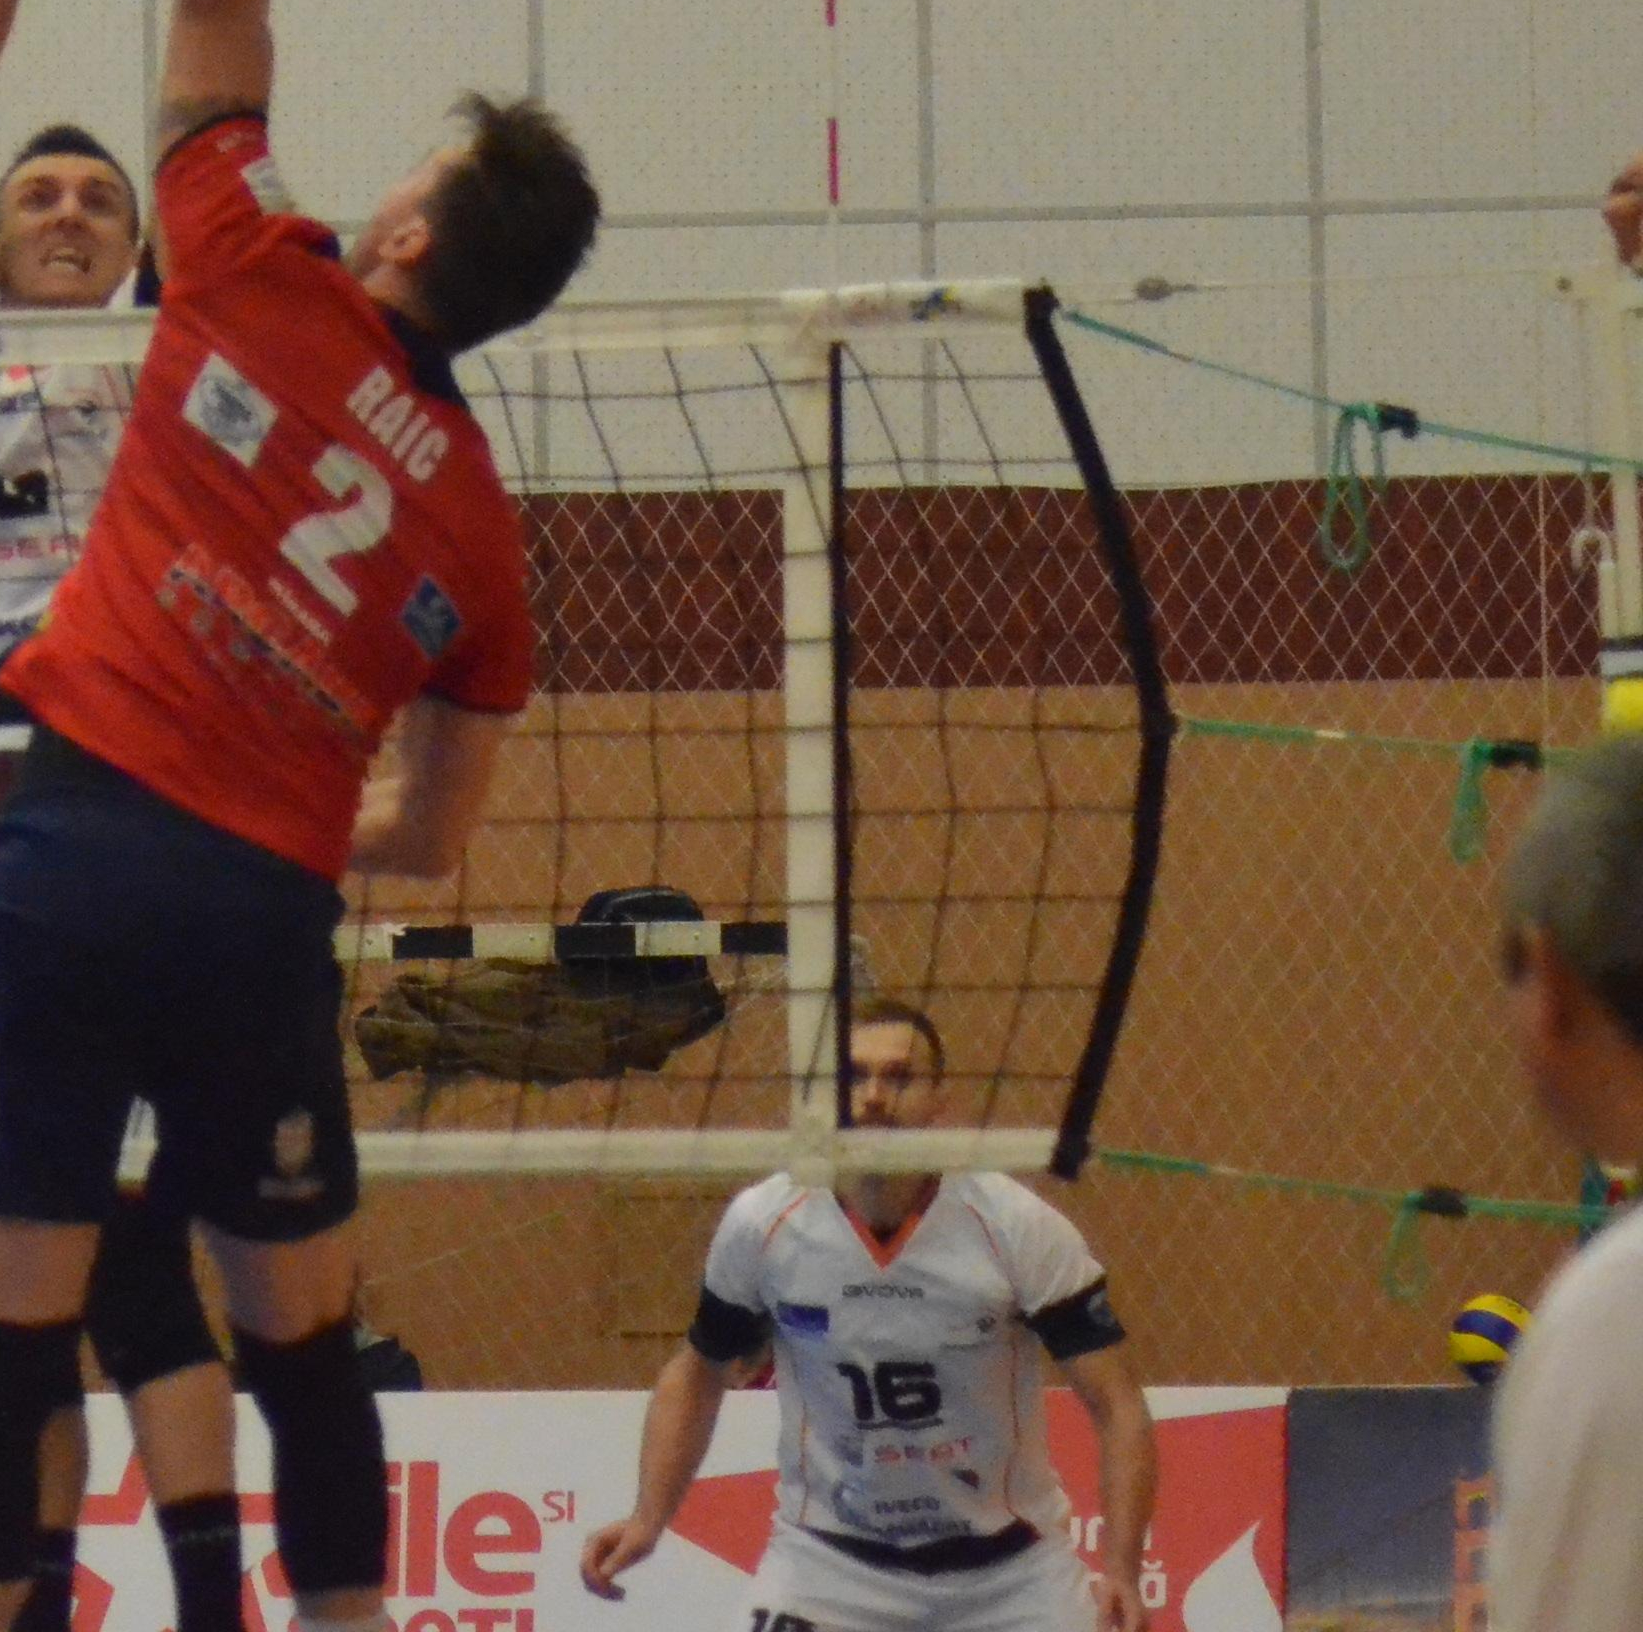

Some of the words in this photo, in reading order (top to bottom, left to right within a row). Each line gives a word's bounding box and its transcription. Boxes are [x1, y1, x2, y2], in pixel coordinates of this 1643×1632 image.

[346, 366, 449, 483] RAIC
[279, 441, 394, 618] 2
[836, 1361, 943, 1421] 16
